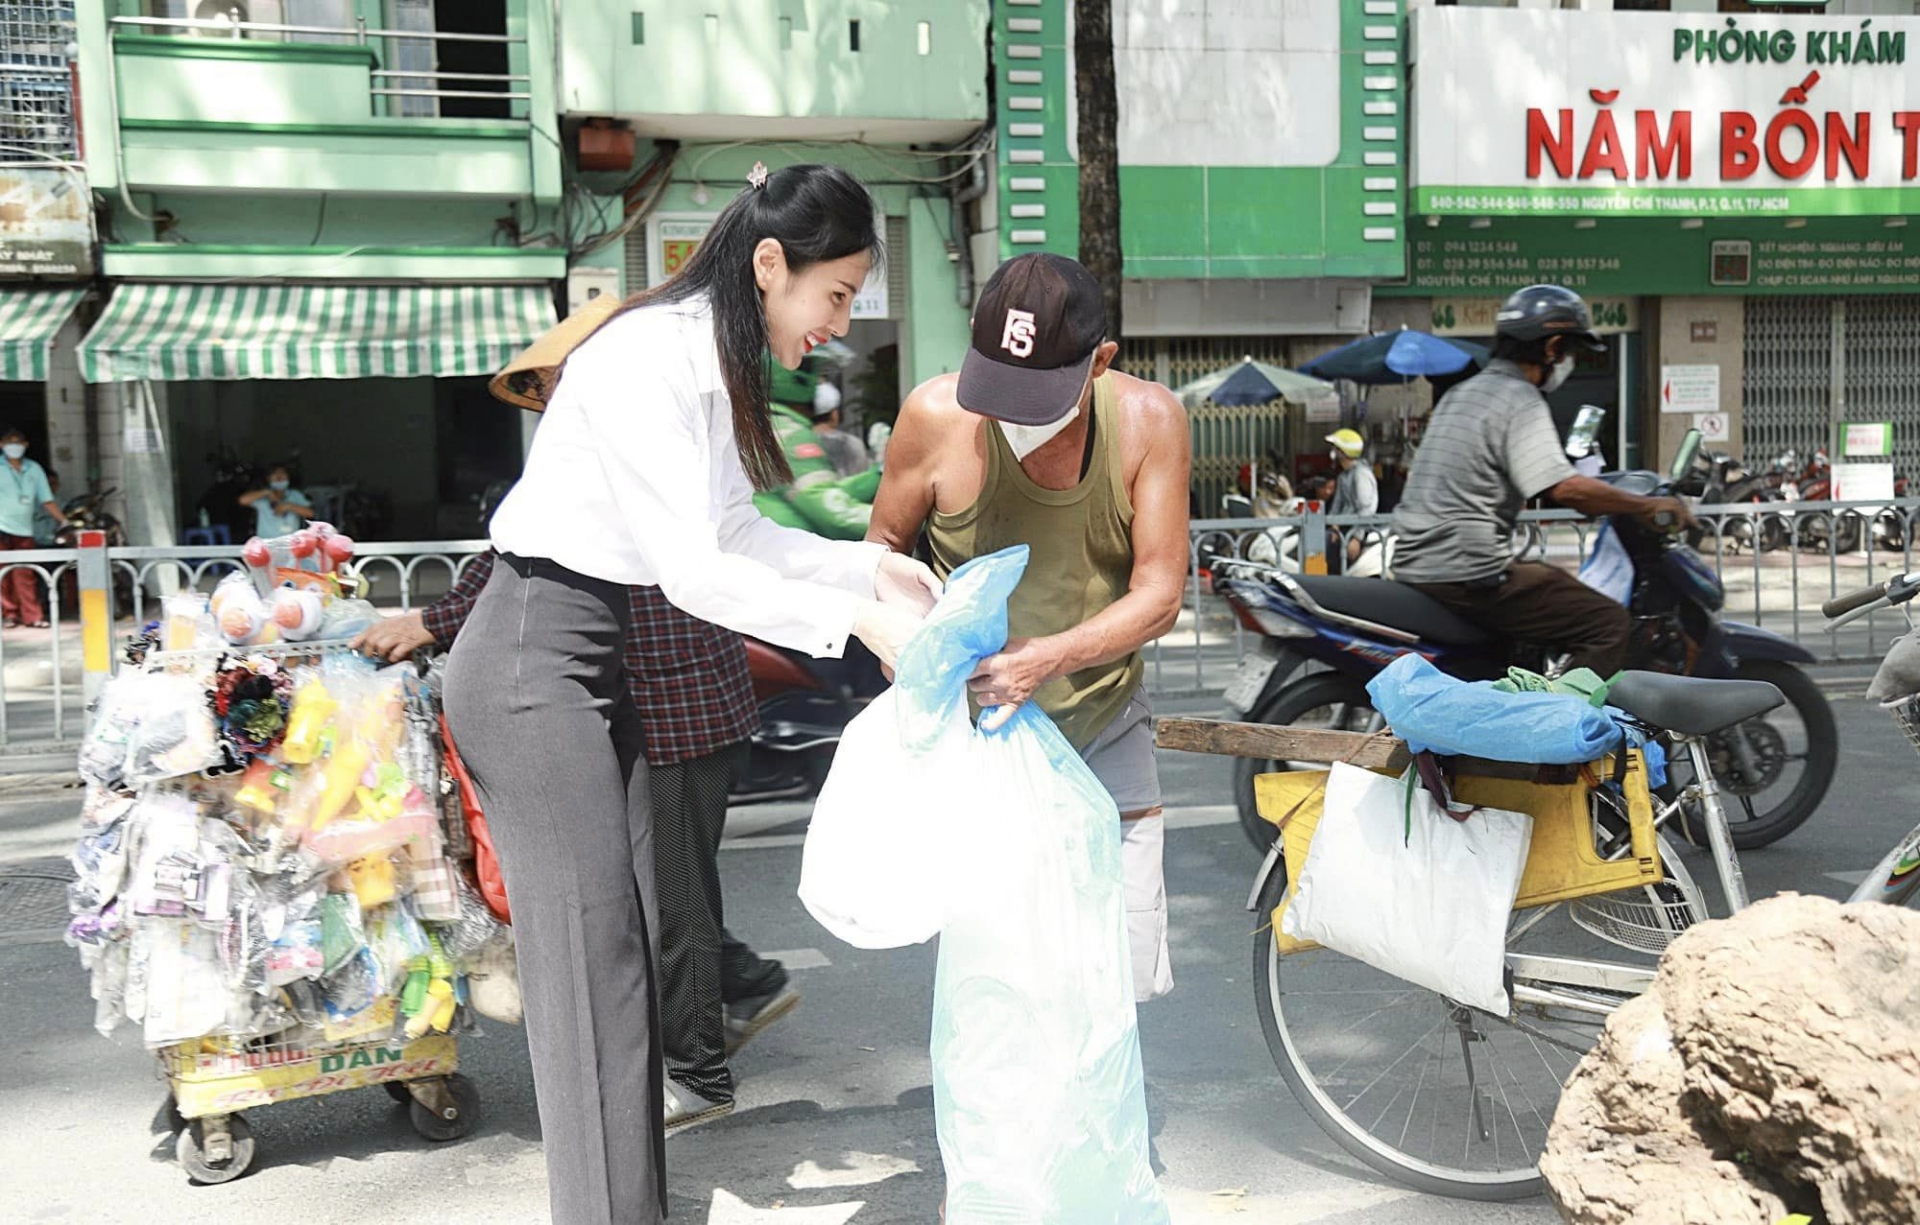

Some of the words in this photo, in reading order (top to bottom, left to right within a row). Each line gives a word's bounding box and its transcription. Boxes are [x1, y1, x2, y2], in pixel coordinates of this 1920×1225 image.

[1673, 17, 1797, 65] PHÒNG
[1806, 18, 1906, 65] KHÁM
[1526, 88, 1692, 181] NĂM
[1719, 69, 1871, 182] BỐN
[1582, 191, 1630, 210] NGUYỄN
[1632, 193, 1653, 210] CHÍ
